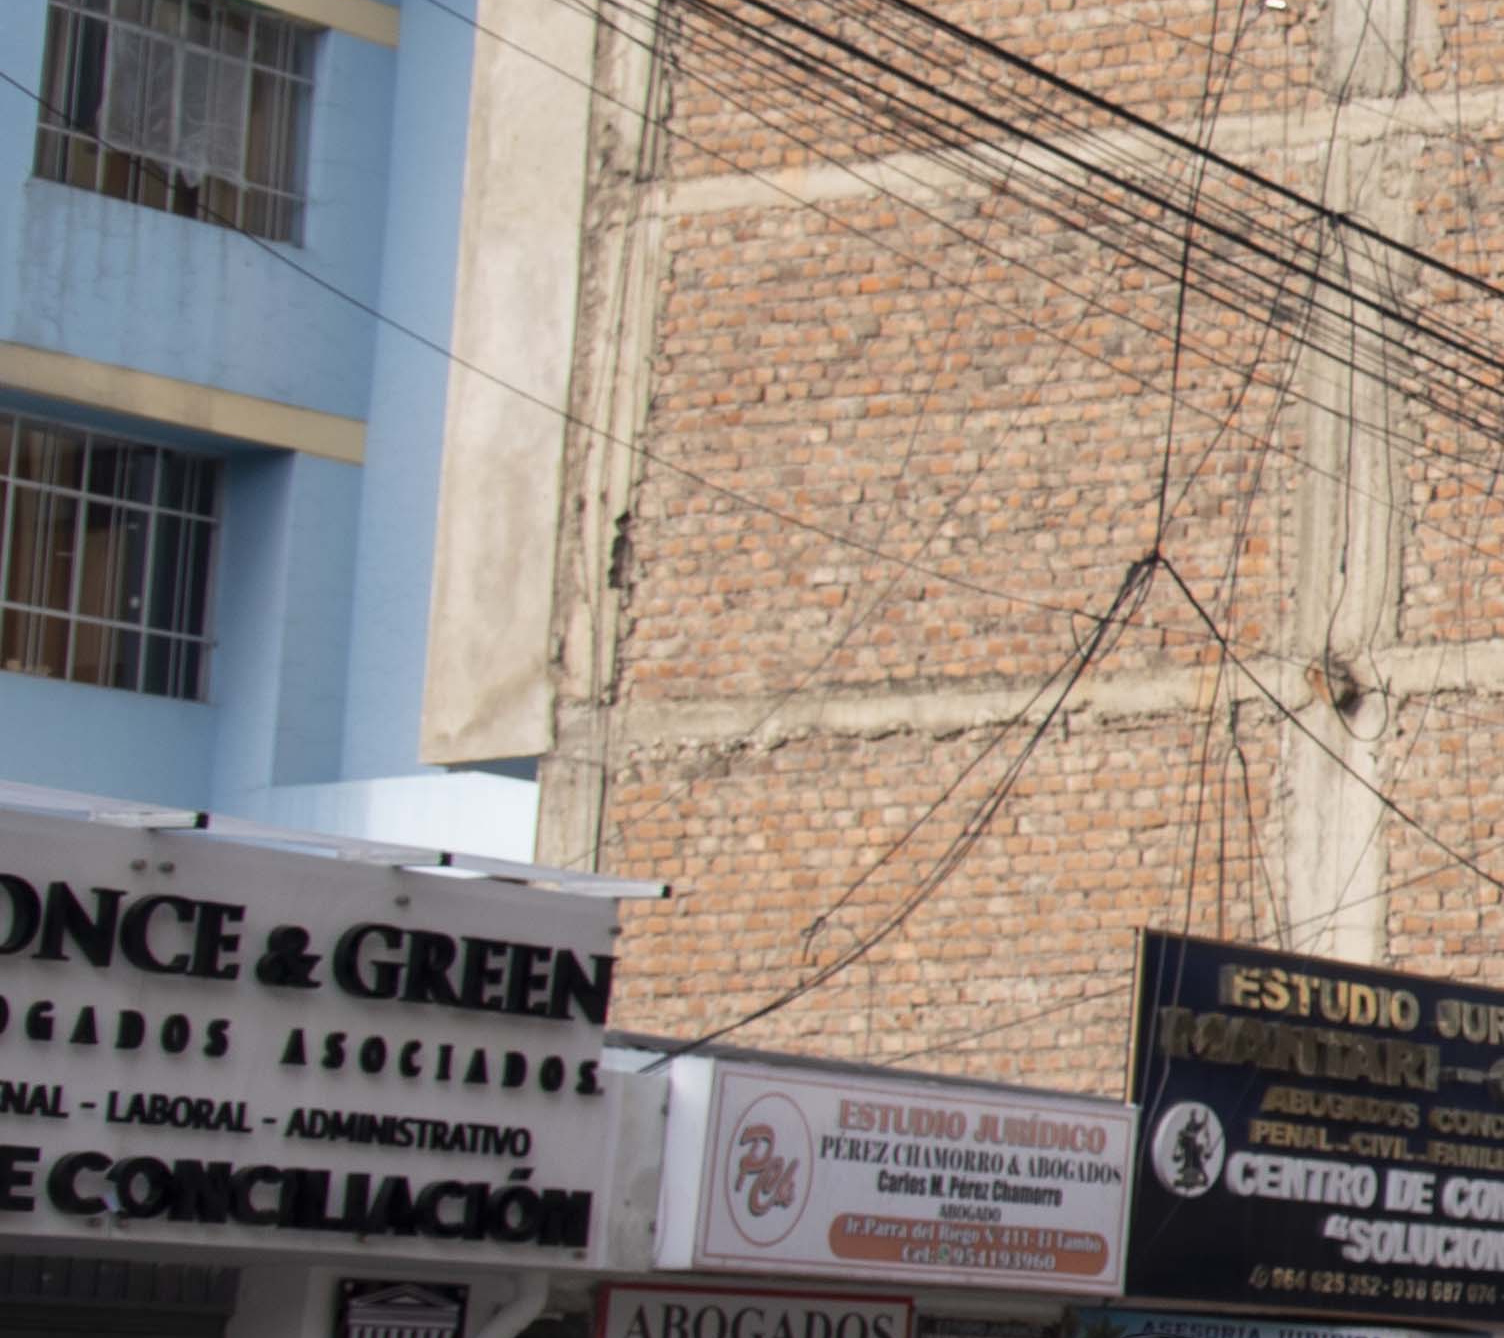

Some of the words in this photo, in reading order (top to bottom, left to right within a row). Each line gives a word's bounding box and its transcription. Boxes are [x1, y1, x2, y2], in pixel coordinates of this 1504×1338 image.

[256, 925, 322, 989] &
[333, 922, 620, 1025] GREEN
[1218, 963, 1420, 1032] ESTUDIO
[106, 1091, 252, 1133] LABORAL
[285, 1107, 532, 1158] ADMINISTRATIVO
[838, 1099, 967, 1141] ESTUDIO
[973, 1114, 1107, 1155] JURÍDICO
[1260, 1085, 1420, 1130] ABOGADOS
[819, 1132, 889, 1164] PÉREZ
[892, 1142, 1004, 1174] CHAMORRO
[1008, 1154, 1021, 1177] &
[1027, 1155, 1123, 1186] ABOGADOS
[1248, 1118, 1334, 1153] PENAL
[1351, 1132, 1414, 1161] CIVIL
[46, 1151, 593, 1248] CONCILIACIÓN
[877, 1169, 927, 1196] Carlos
[949, 1174, 989, 1202] Pérez
[992, 1179, 1063, 1208] Chamorro
[1225, 1151, 1379, 1209] CENTRO
[1384, 1168, 1437, 1214] DE
[939, 1204, 1002, 1223] ABOGADO
